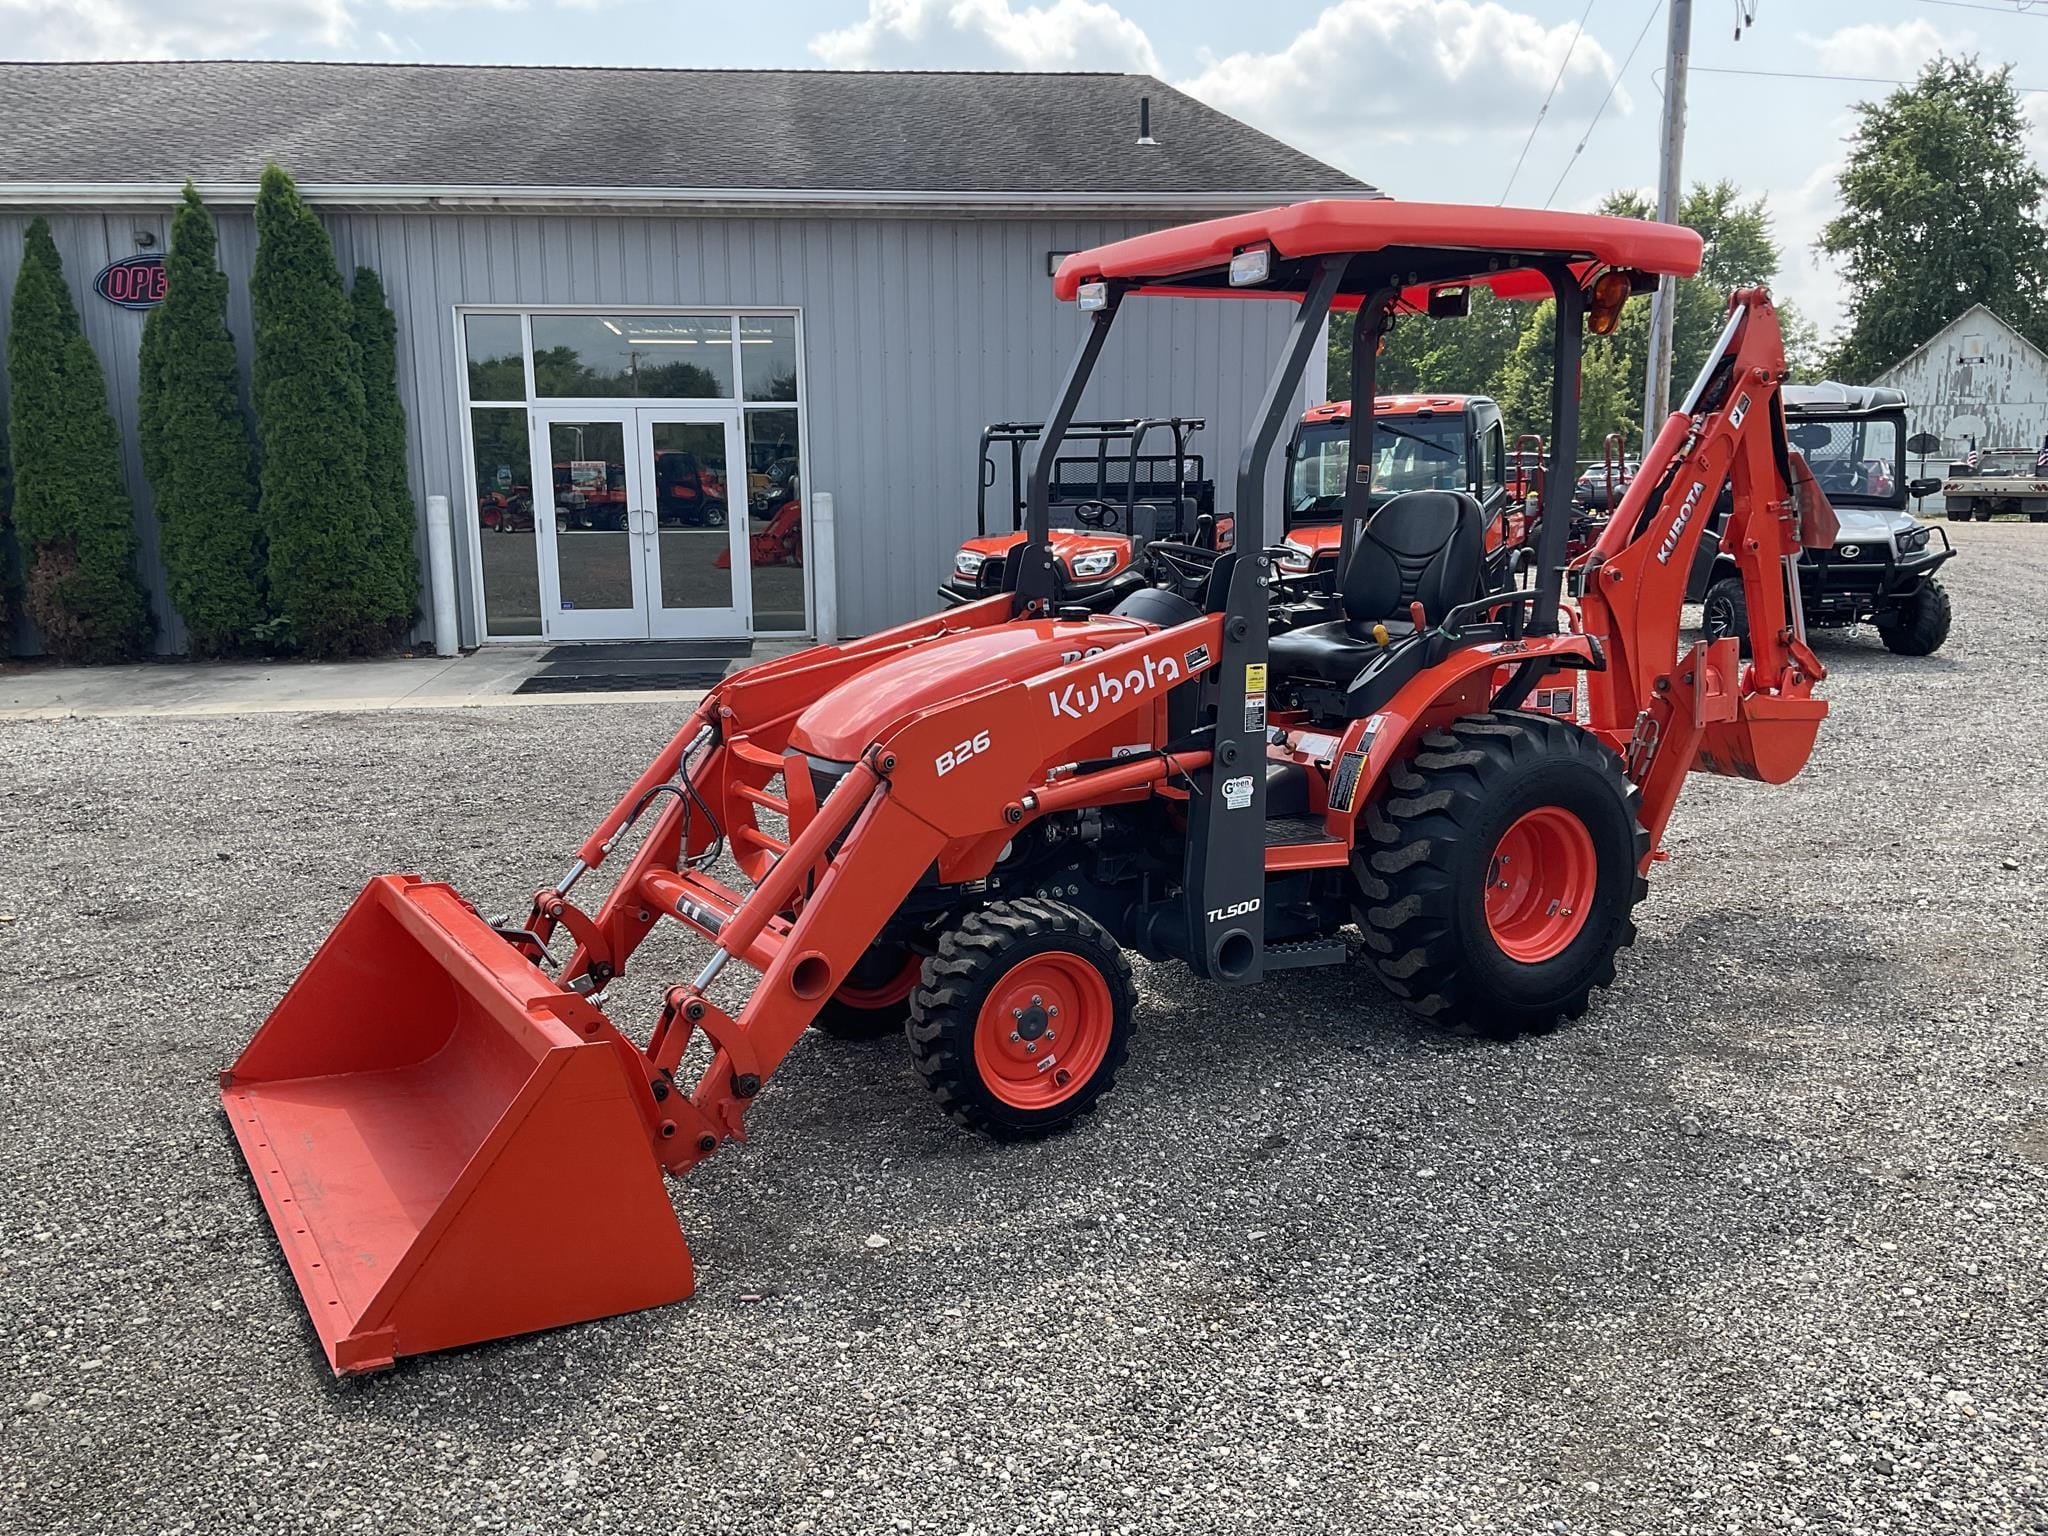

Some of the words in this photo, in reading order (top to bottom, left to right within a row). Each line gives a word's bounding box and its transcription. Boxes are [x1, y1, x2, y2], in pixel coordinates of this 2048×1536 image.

[108, 266, 169, 299] OPE
[1656, 481, 1706, 565] KUBOTA
[1048, 654, 1180, 719] Kubota
[935, 729, 991, 777] B26
[1224, 780, 1250, 794] Green
[1207, 898, 1261, 923] TL500
